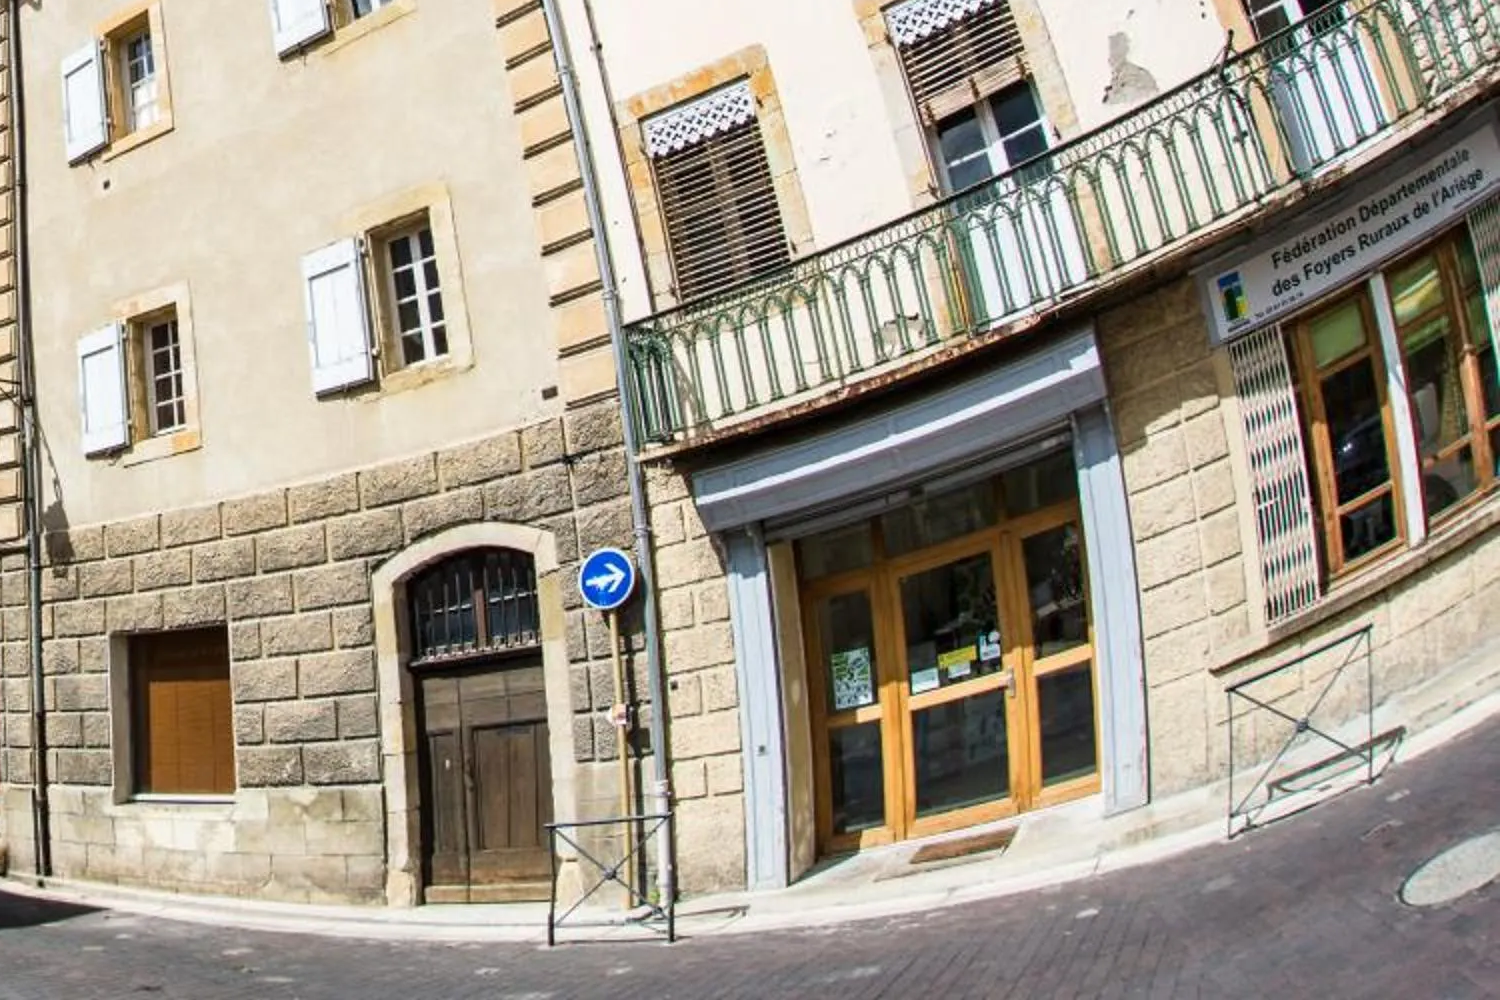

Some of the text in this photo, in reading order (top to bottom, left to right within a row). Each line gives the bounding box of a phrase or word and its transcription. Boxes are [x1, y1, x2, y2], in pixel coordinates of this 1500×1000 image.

[1271, 215, 1357, 269] Fédération
[1358, 149, 1470, 223] Départementale
[1272, 274, 1301, 297] des
[1303, 246, 1357, 281] Foyers
[1357, 214, 1410, 252] Ruraux
[1412, 201, 1430, 219] de
[1431, 167, 1484, 208] l'Ariège
